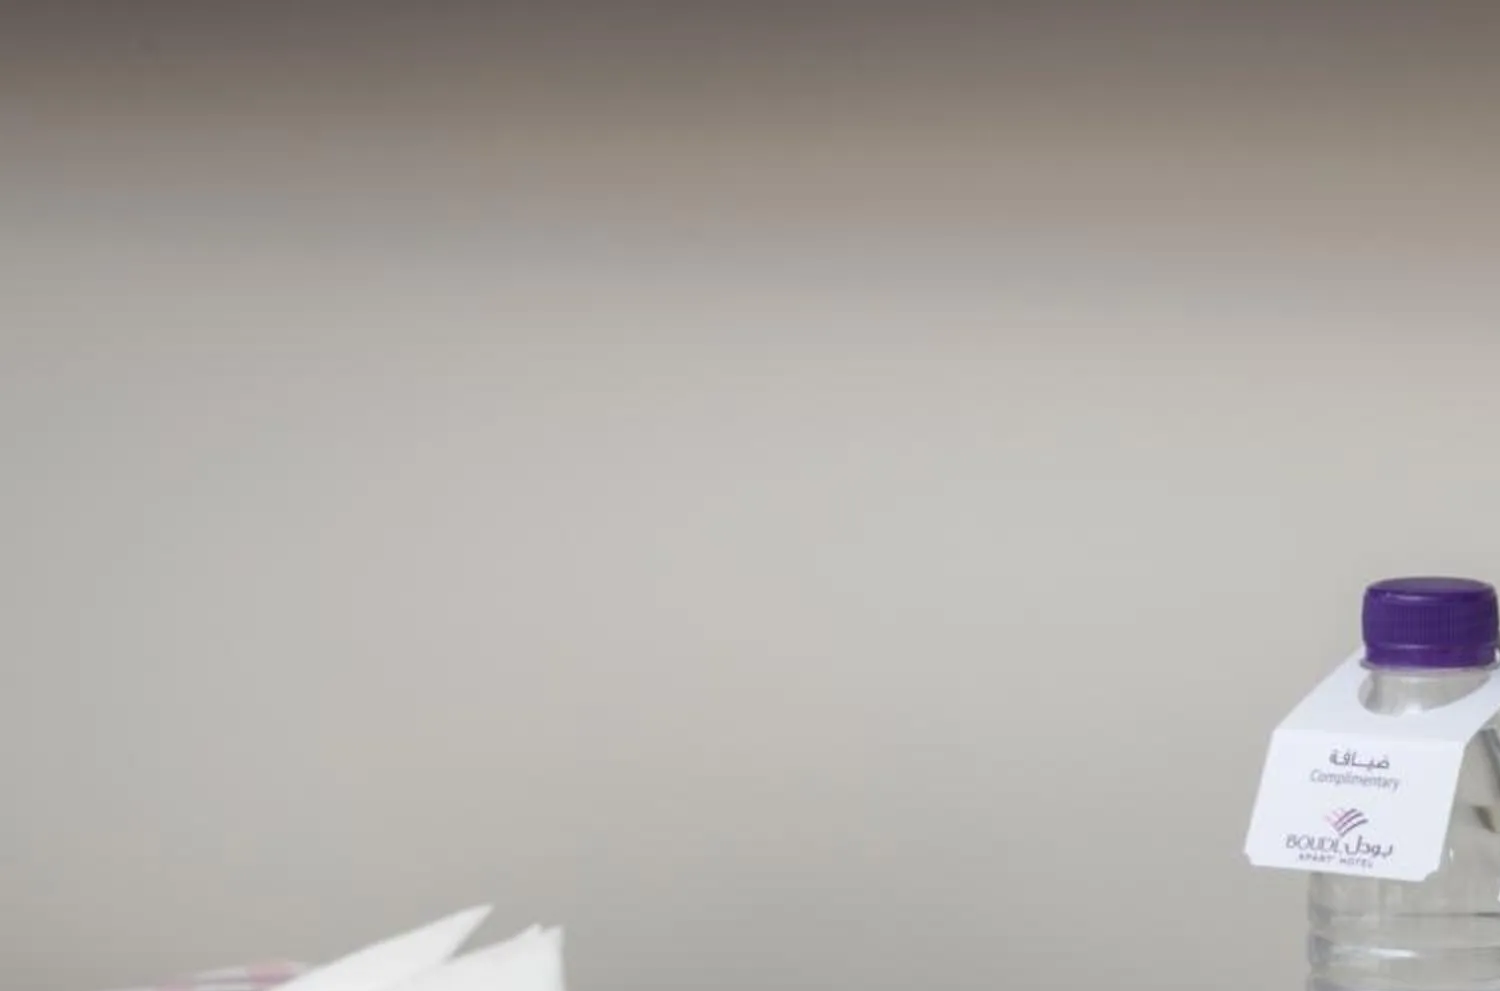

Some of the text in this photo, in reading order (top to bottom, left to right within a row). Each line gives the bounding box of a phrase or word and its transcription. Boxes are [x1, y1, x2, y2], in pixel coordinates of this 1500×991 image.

[1310, 769, 1402, 791] Complimentary
[1285, 833, 1342, 853] BOUDL
[1340, 858, 1374, 868] HOTEL
